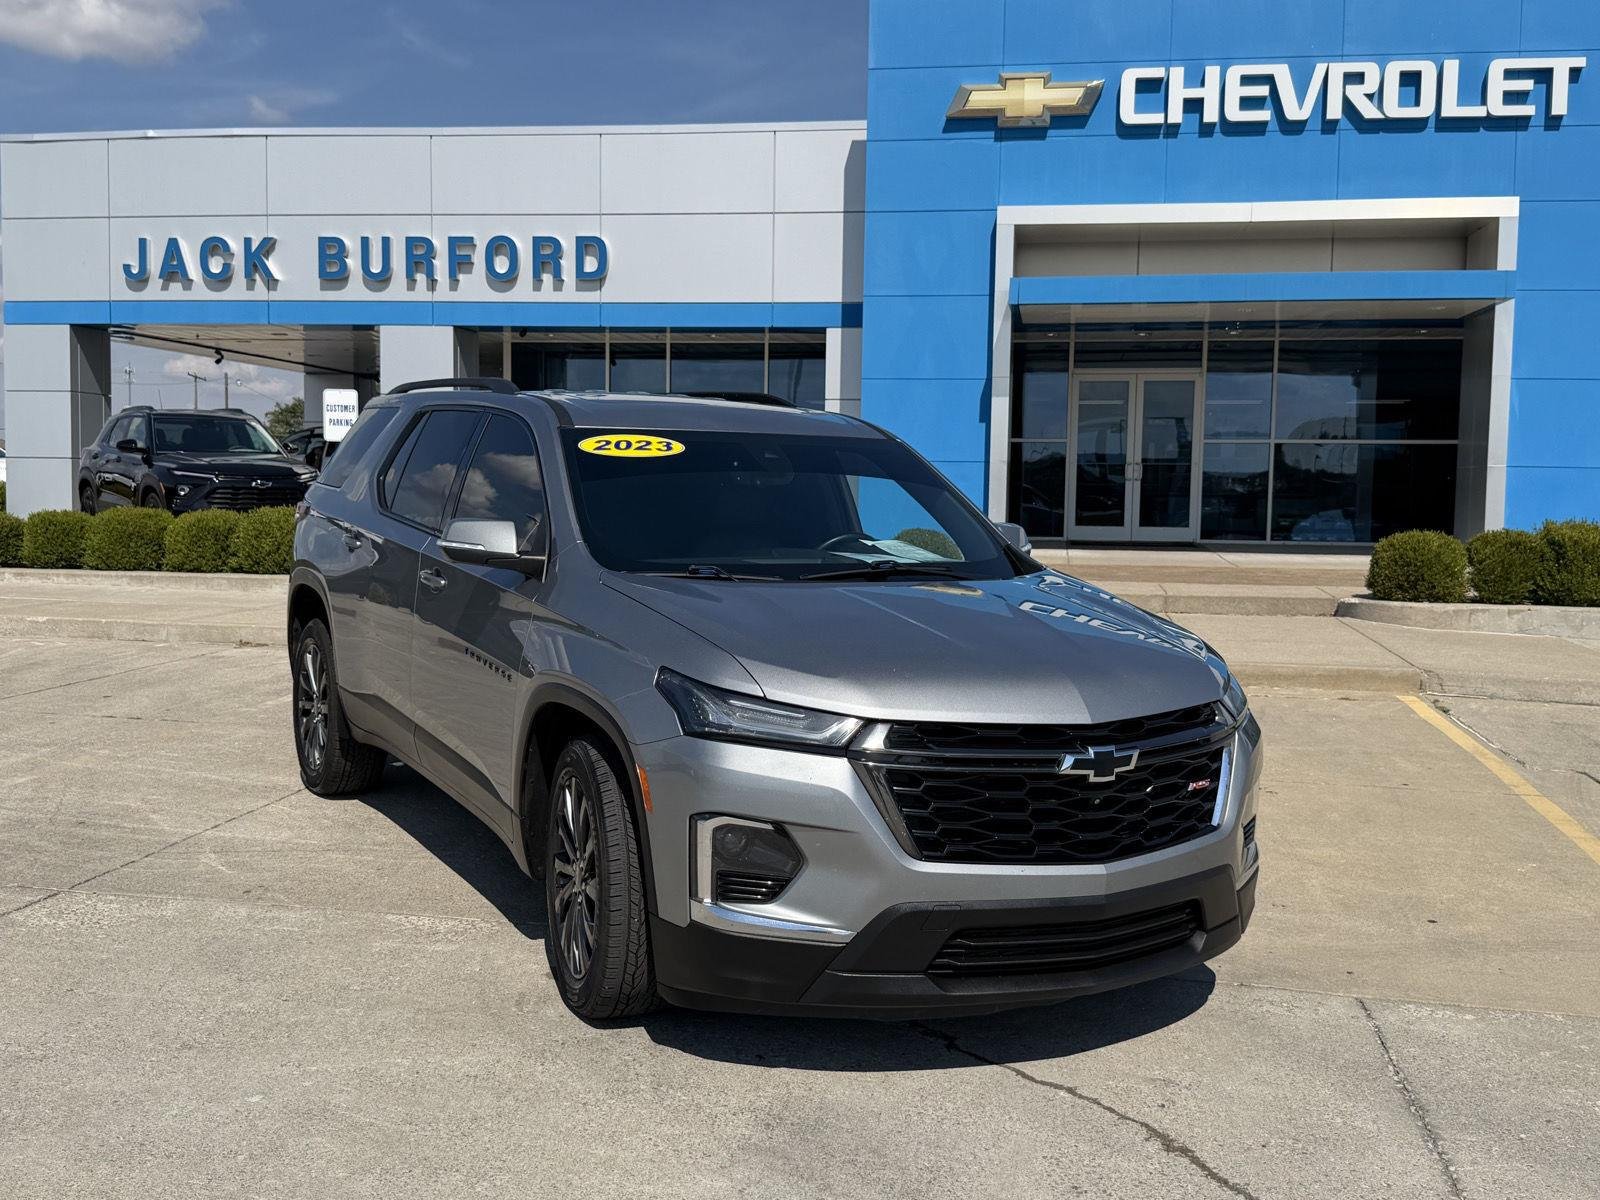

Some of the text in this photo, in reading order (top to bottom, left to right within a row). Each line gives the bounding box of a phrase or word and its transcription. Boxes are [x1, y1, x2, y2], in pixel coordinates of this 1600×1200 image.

[1119, 56, 1587, 126] CHEVROLET
[122, 235, 609, 282] JACK BURFORD
[326, 404, 356, 413] CUSTOMER
[328, 418, 354, 427] PARKING
[592, 439, 674, 452] 2023
